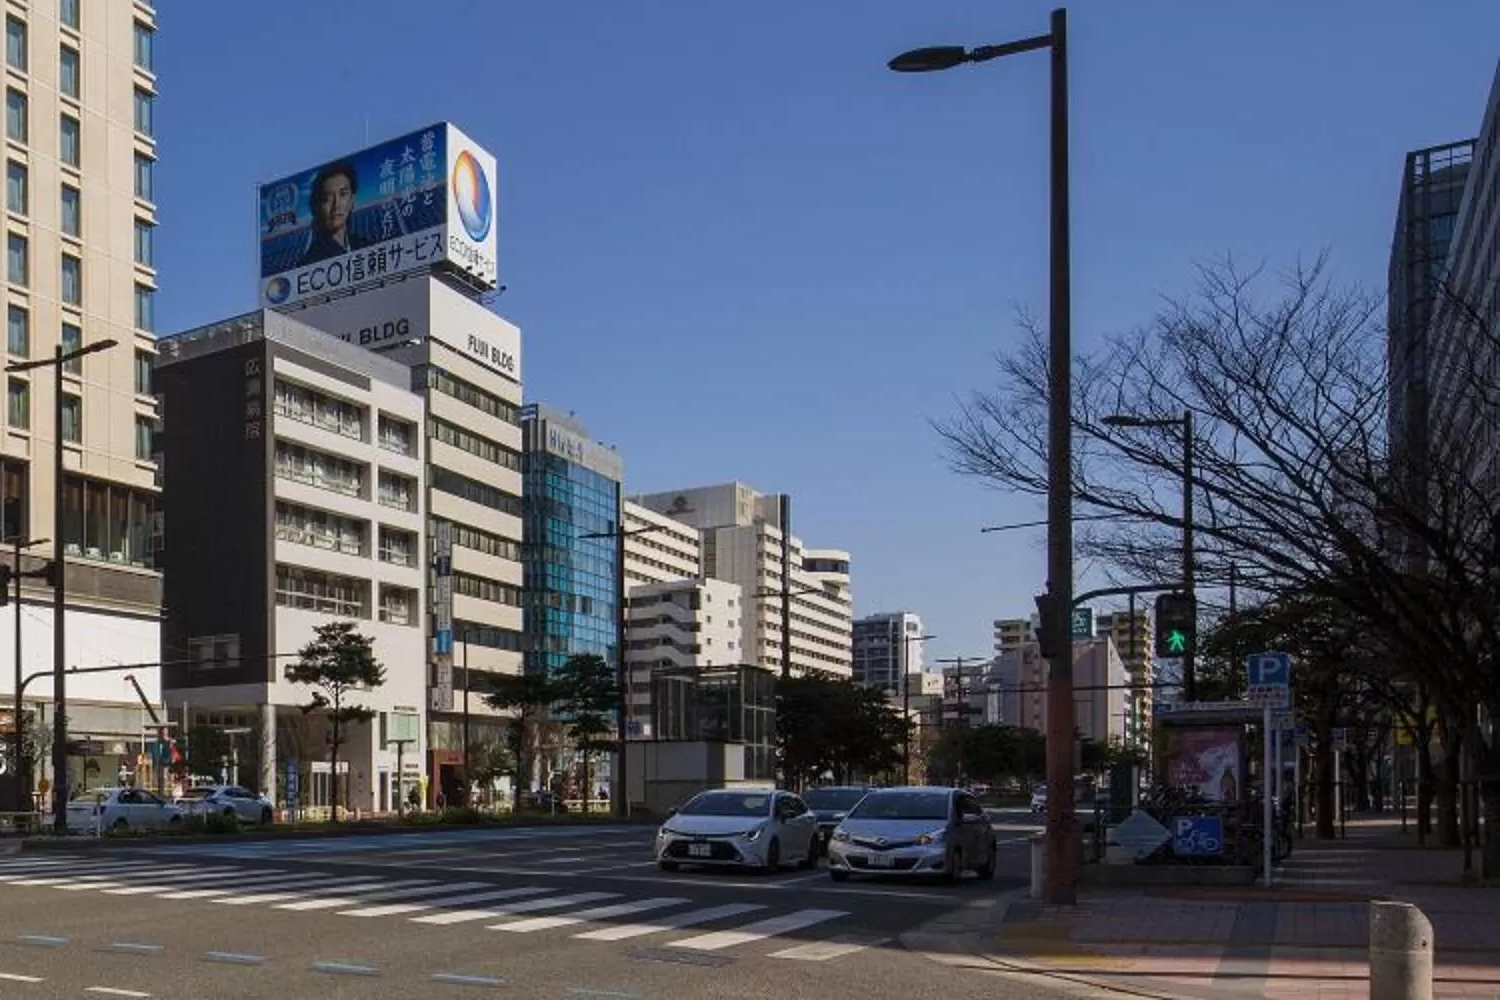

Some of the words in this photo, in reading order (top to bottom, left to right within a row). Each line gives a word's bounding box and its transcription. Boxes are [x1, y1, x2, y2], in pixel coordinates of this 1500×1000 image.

[297, 232, 443, 295] ECO信頼サービス
[359, 317, 409, 345] BLDG
[491, 346, 515, 372] BLDG
[1259, 657, 1280, 682] P
[1177, 819, 1193, 837] P
